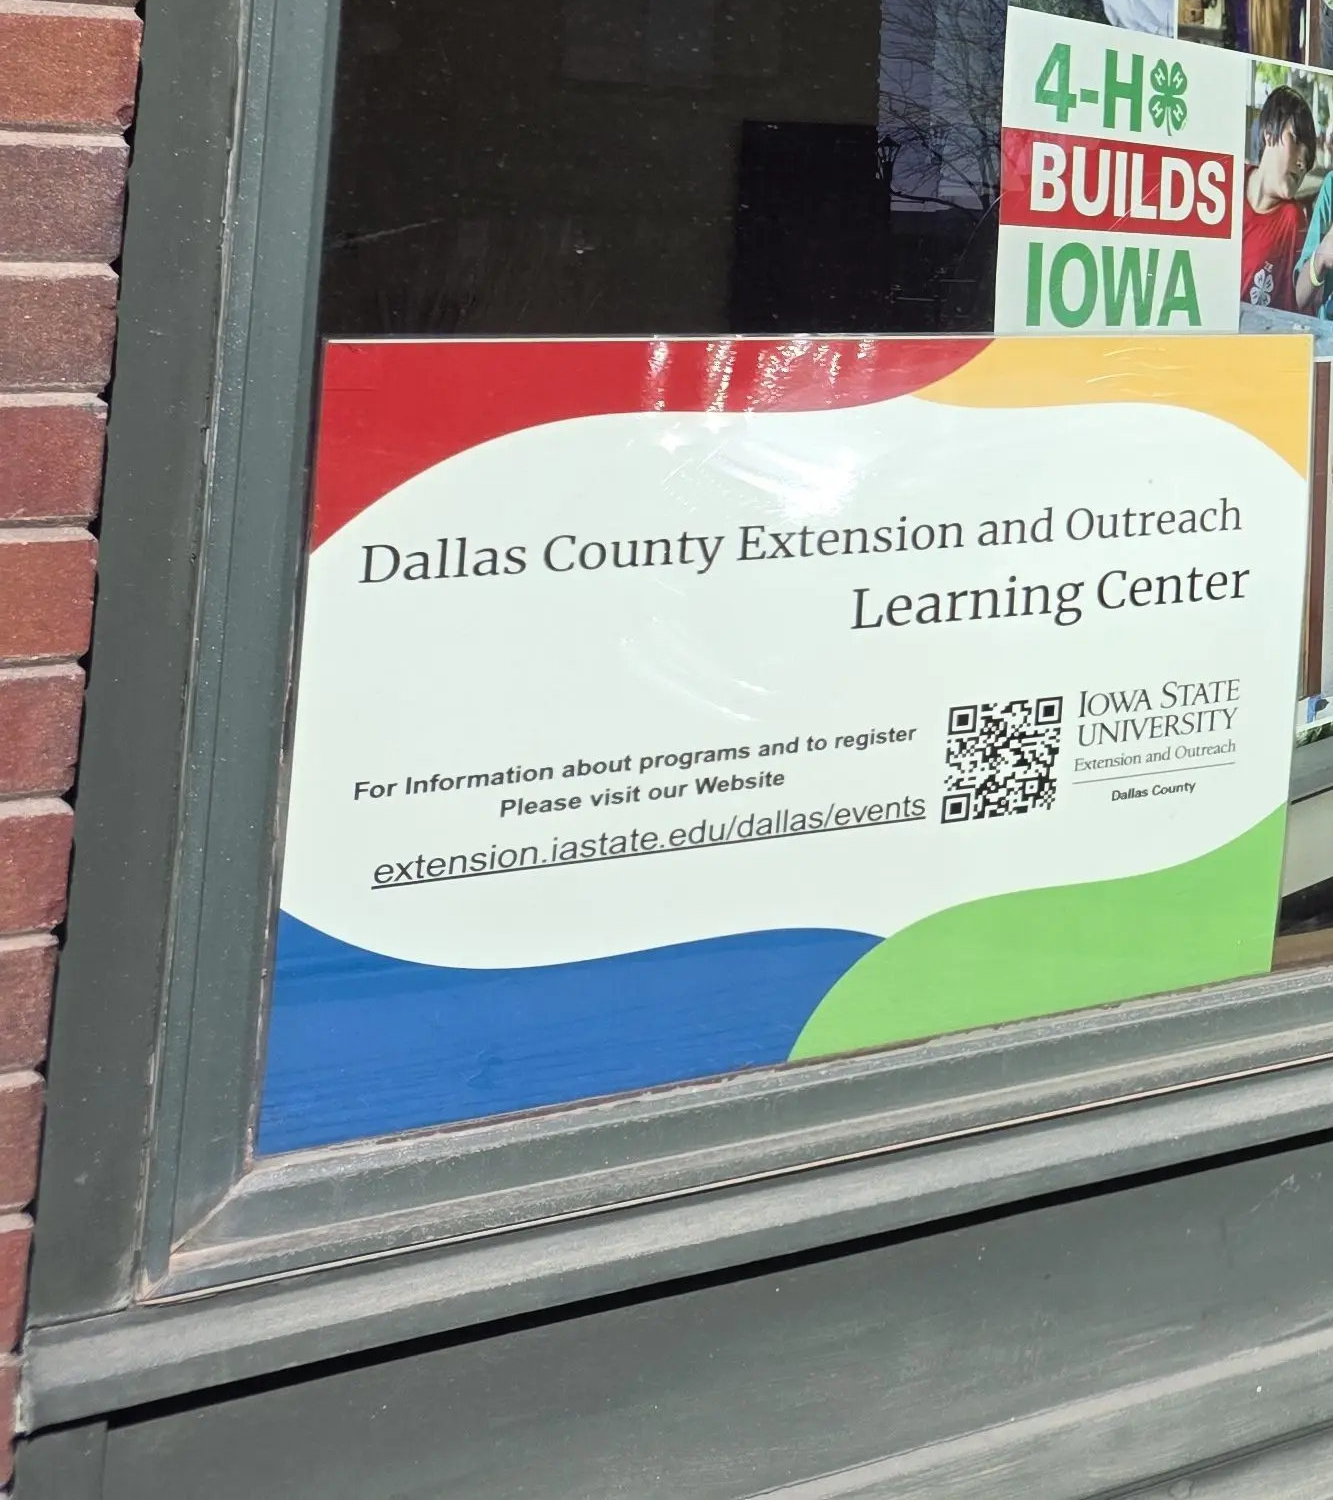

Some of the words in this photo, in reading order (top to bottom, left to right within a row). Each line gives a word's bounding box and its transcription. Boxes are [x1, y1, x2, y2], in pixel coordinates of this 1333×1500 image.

[1034, 42, 1145, 133] 4-H
[1030, 141, 1227, 225] BUILDS
[1025, 242, 1202, 328] IOWA
[358, 537, 527, 584] Dallas
[543, 530, 725, 575] County
[736, 515, 964, 562] Extension
[976, 507, 1053, 547] and
[1066, 498, 1242, 541] Outreach
[850, 575, 1085, 630] Learning
[1097, 567, 1251, 609] Center
[1077, 707, 1239, 747] UNIVERSITY
[1078, 688, 1153, 718] IOWA
[1160, 678, 1241, 709] STATE
[353, 780, 397, 801] For
[405, 764, 554, 796] Information
[561, 755, 633, 780] about
[639, 745, 751, 774] programs
[758, 737, 799, 758] and
[806, 735, 828, 753] to
[833, 726, 917, 752] register
[1073, 753, 1142, 772] Extension
[1145, 746, 1171, 763] and
[1174, 739, 1236, 759] Outreach
[499, 795, 582, 818] Please
[590, 786, 641, 807] visit
[648, 782, 688, 800] our
[695, 769, 786, 795] Website
[1111, 787, 1149, 801] Dallas
[1152, 781, 1197, 797] County
[371, 796, 927, 888] extension.iastate.edu/dallas/events
